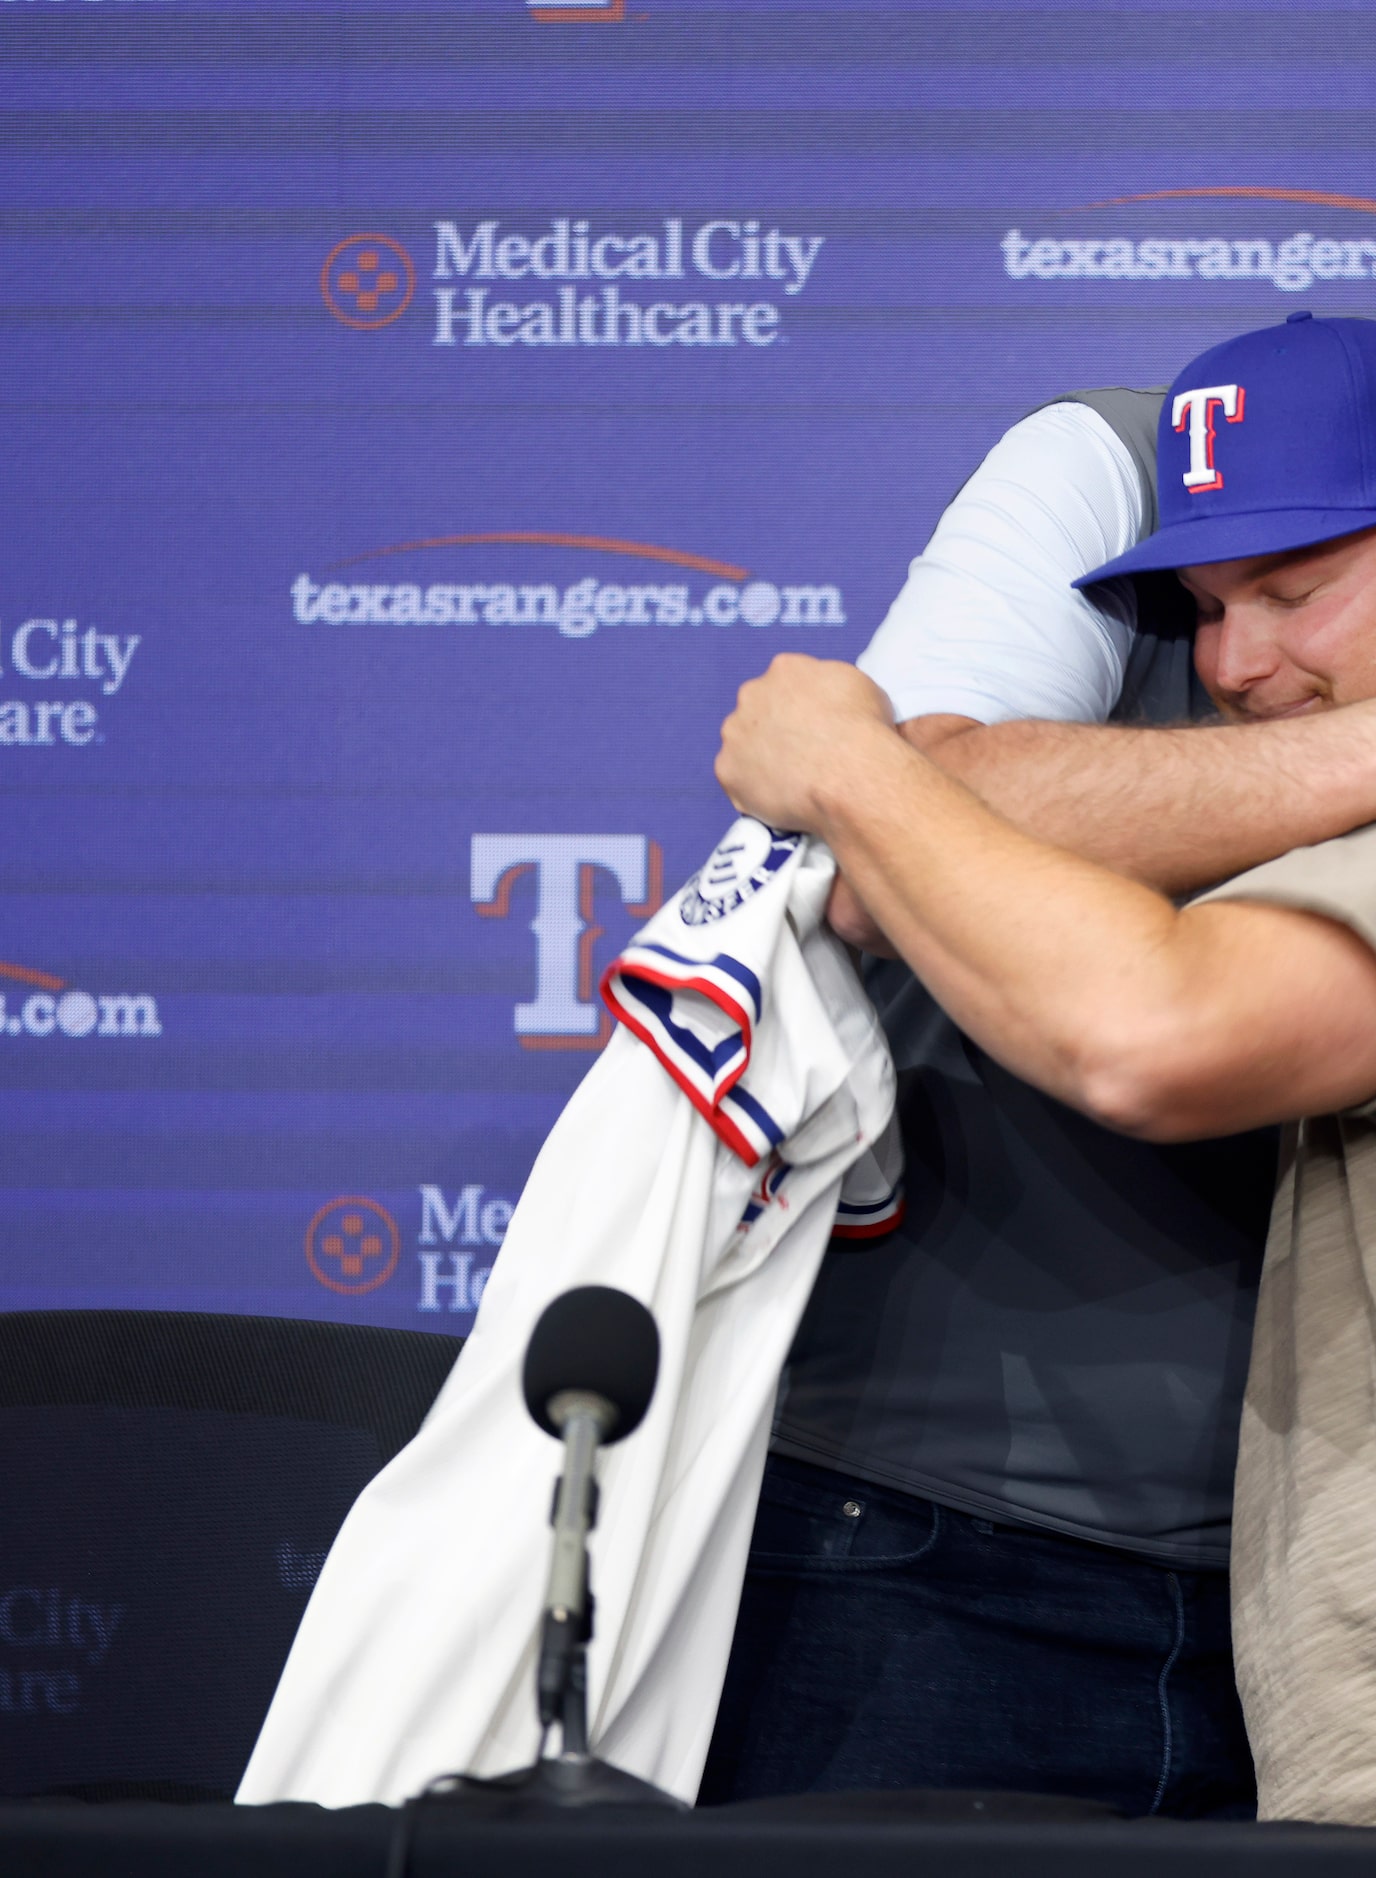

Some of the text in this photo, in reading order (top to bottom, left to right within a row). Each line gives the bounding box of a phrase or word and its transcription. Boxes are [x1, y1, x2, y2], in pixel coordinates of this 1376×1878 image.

[432, 217, 826, 296] Medical City
[432, 284, 784, 347] Healthcare
[1172, 384, 1246, 494] T
[291, 573, 846, 638] texasrangers.com
[11, 618, 142, 696] City
